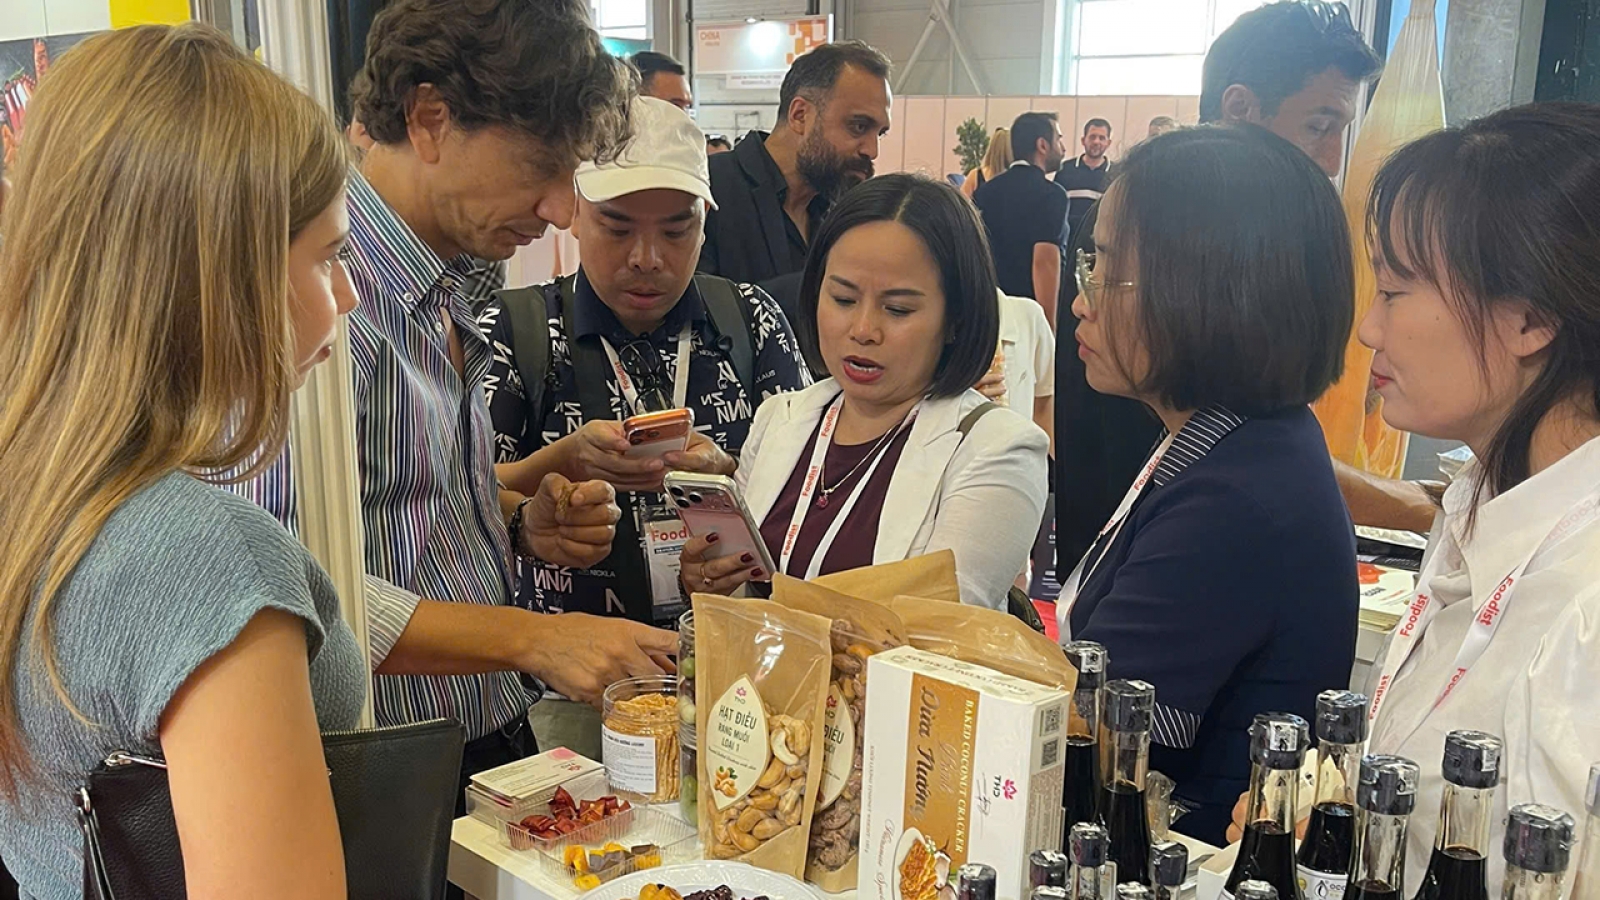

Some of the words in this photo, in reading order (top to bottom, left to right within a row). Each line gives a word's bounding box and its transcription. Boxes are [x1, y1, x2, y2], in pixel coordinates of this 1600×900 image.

[821, 406, 838, 438] Foodist
[802, 465, 818, 497] Foodist
[651, 526, 687, 542] Food
[783, 524, 799, 556] Foodist
[1400, 594, 1429, 638] Foodist
[1479, 575, 1514, 626] Foodist
[964, 699, 975, 741] BAKED
[959, 741, 972, 796] COCONUT
[955, 799, 967, 853] CRACKER
